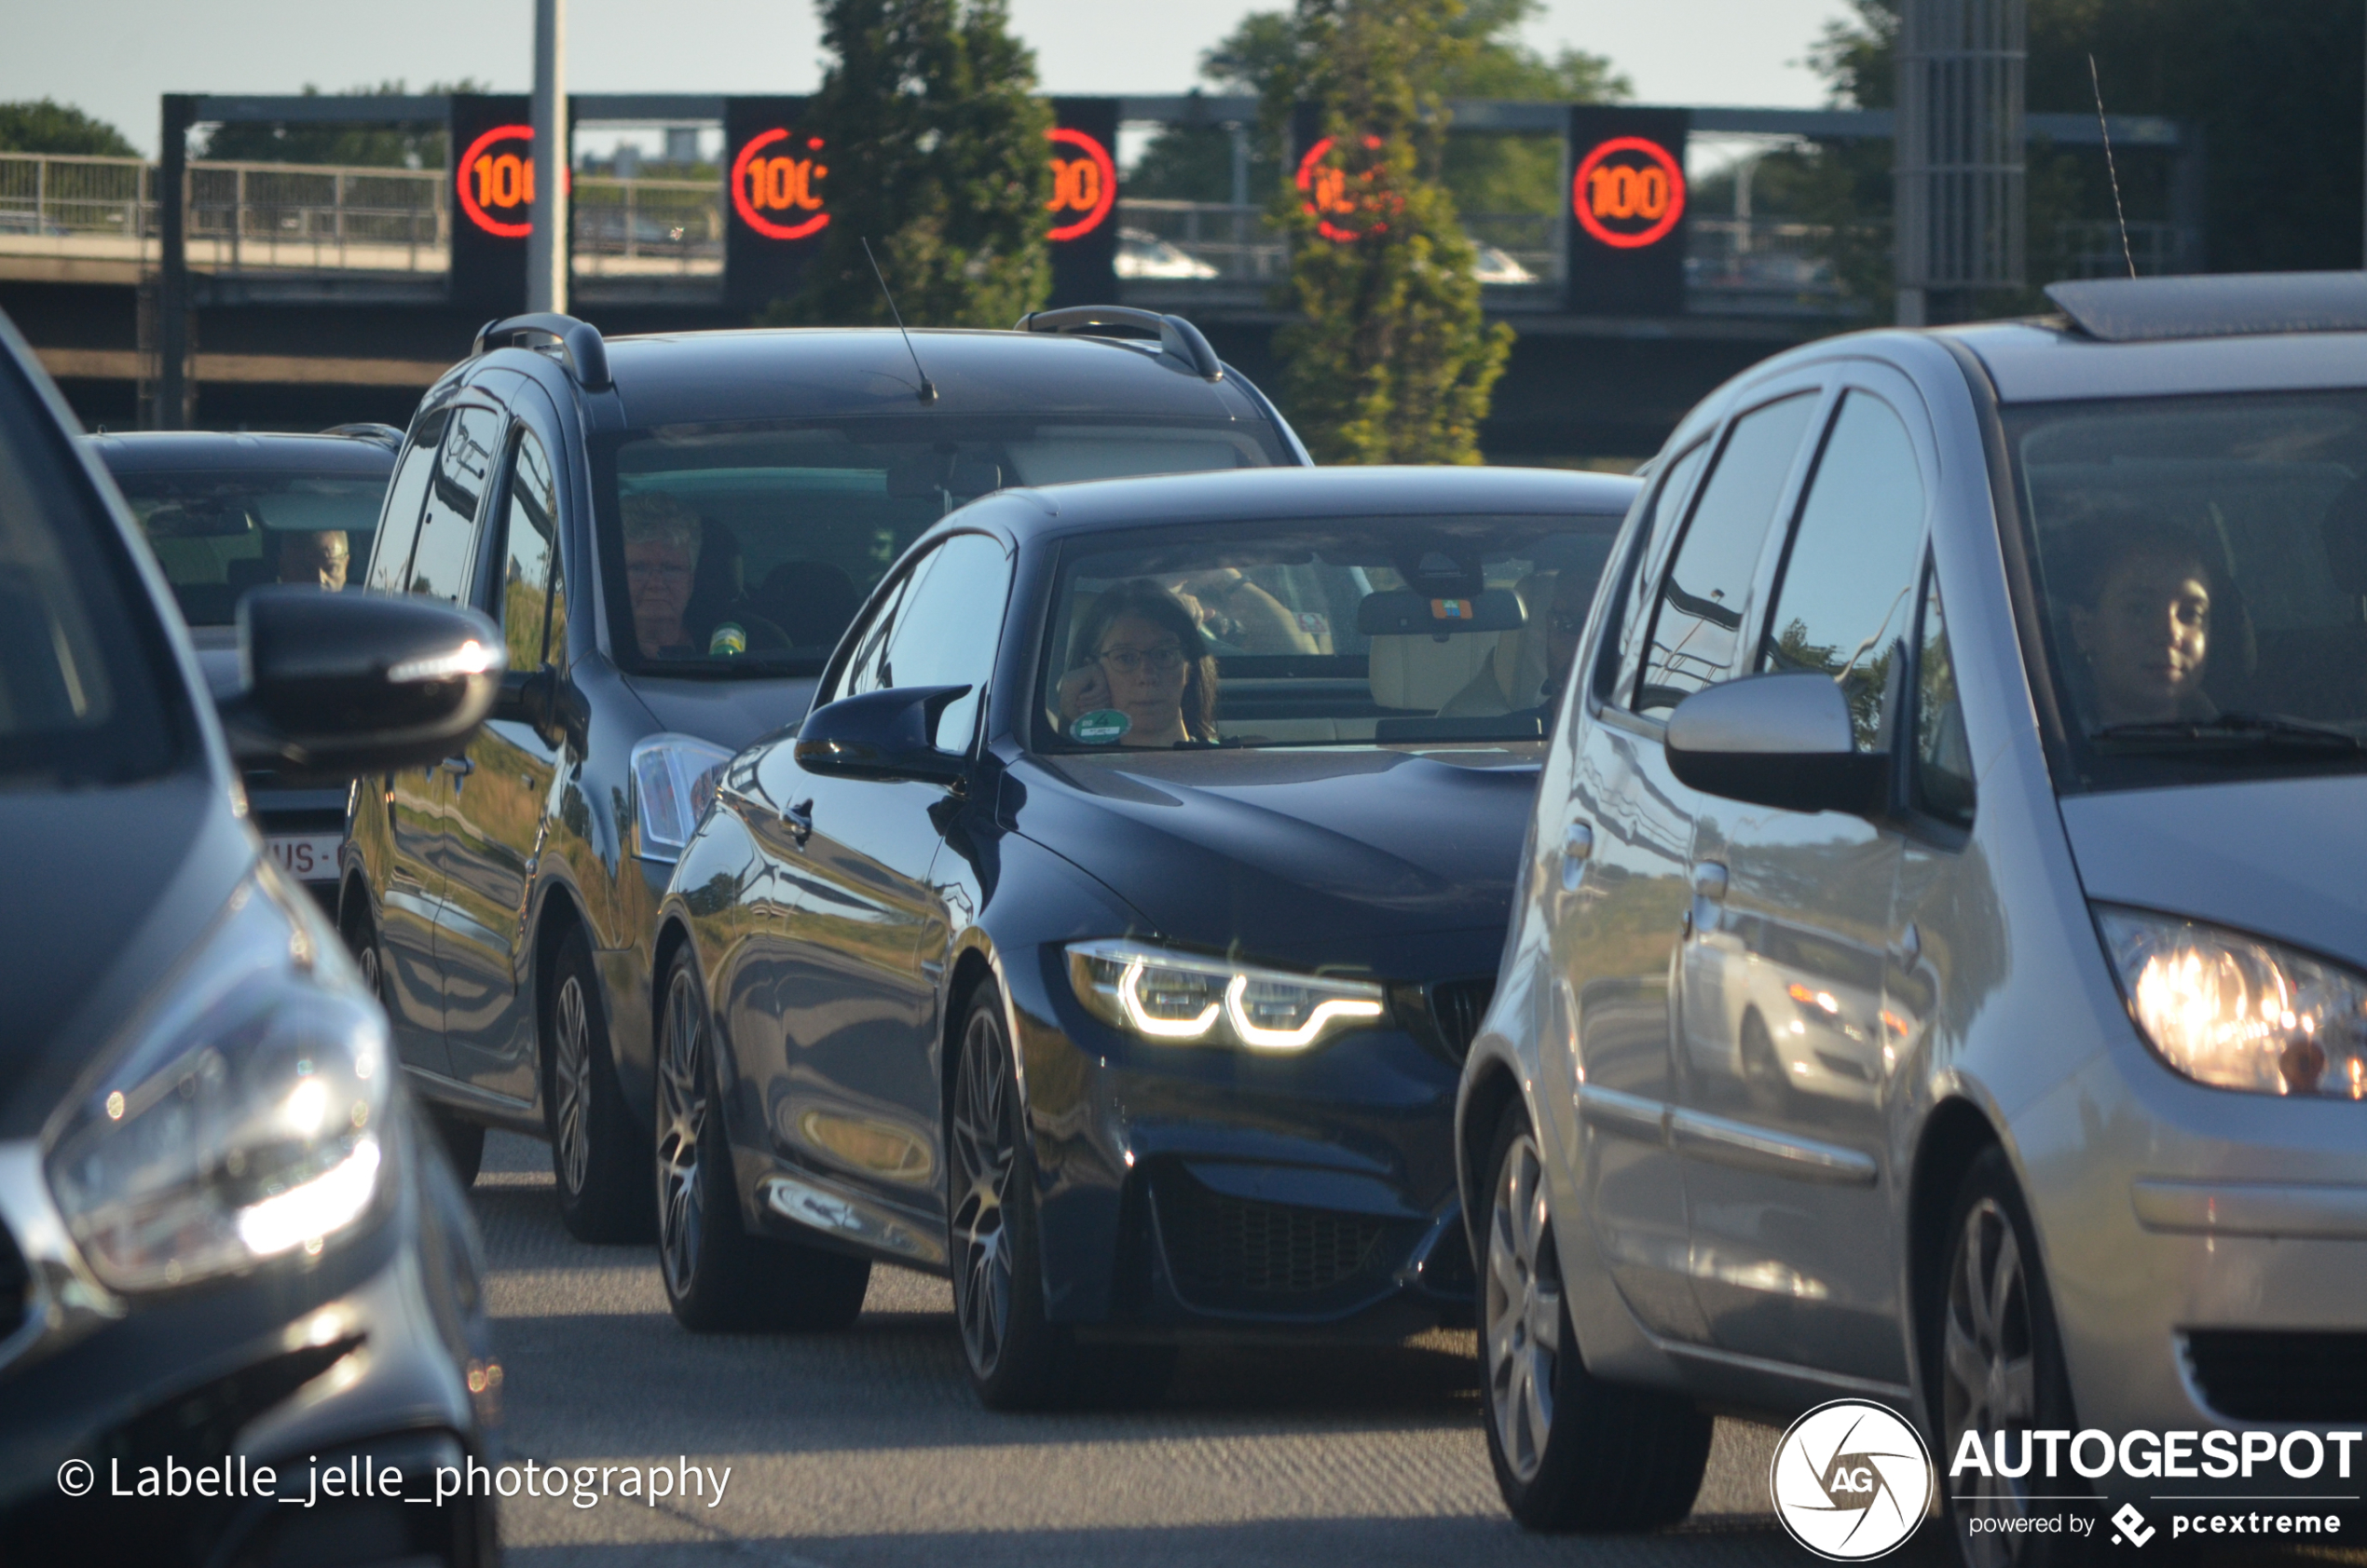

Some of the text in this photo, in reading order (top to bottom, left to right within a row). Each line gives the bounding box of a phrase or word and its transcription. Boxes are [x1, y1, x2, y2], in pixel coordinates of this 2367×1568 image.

[1045, 157, 1099, 211] 00
[1588, 164, 1667, 219] 100
[265, 842, 343, 873] US-
